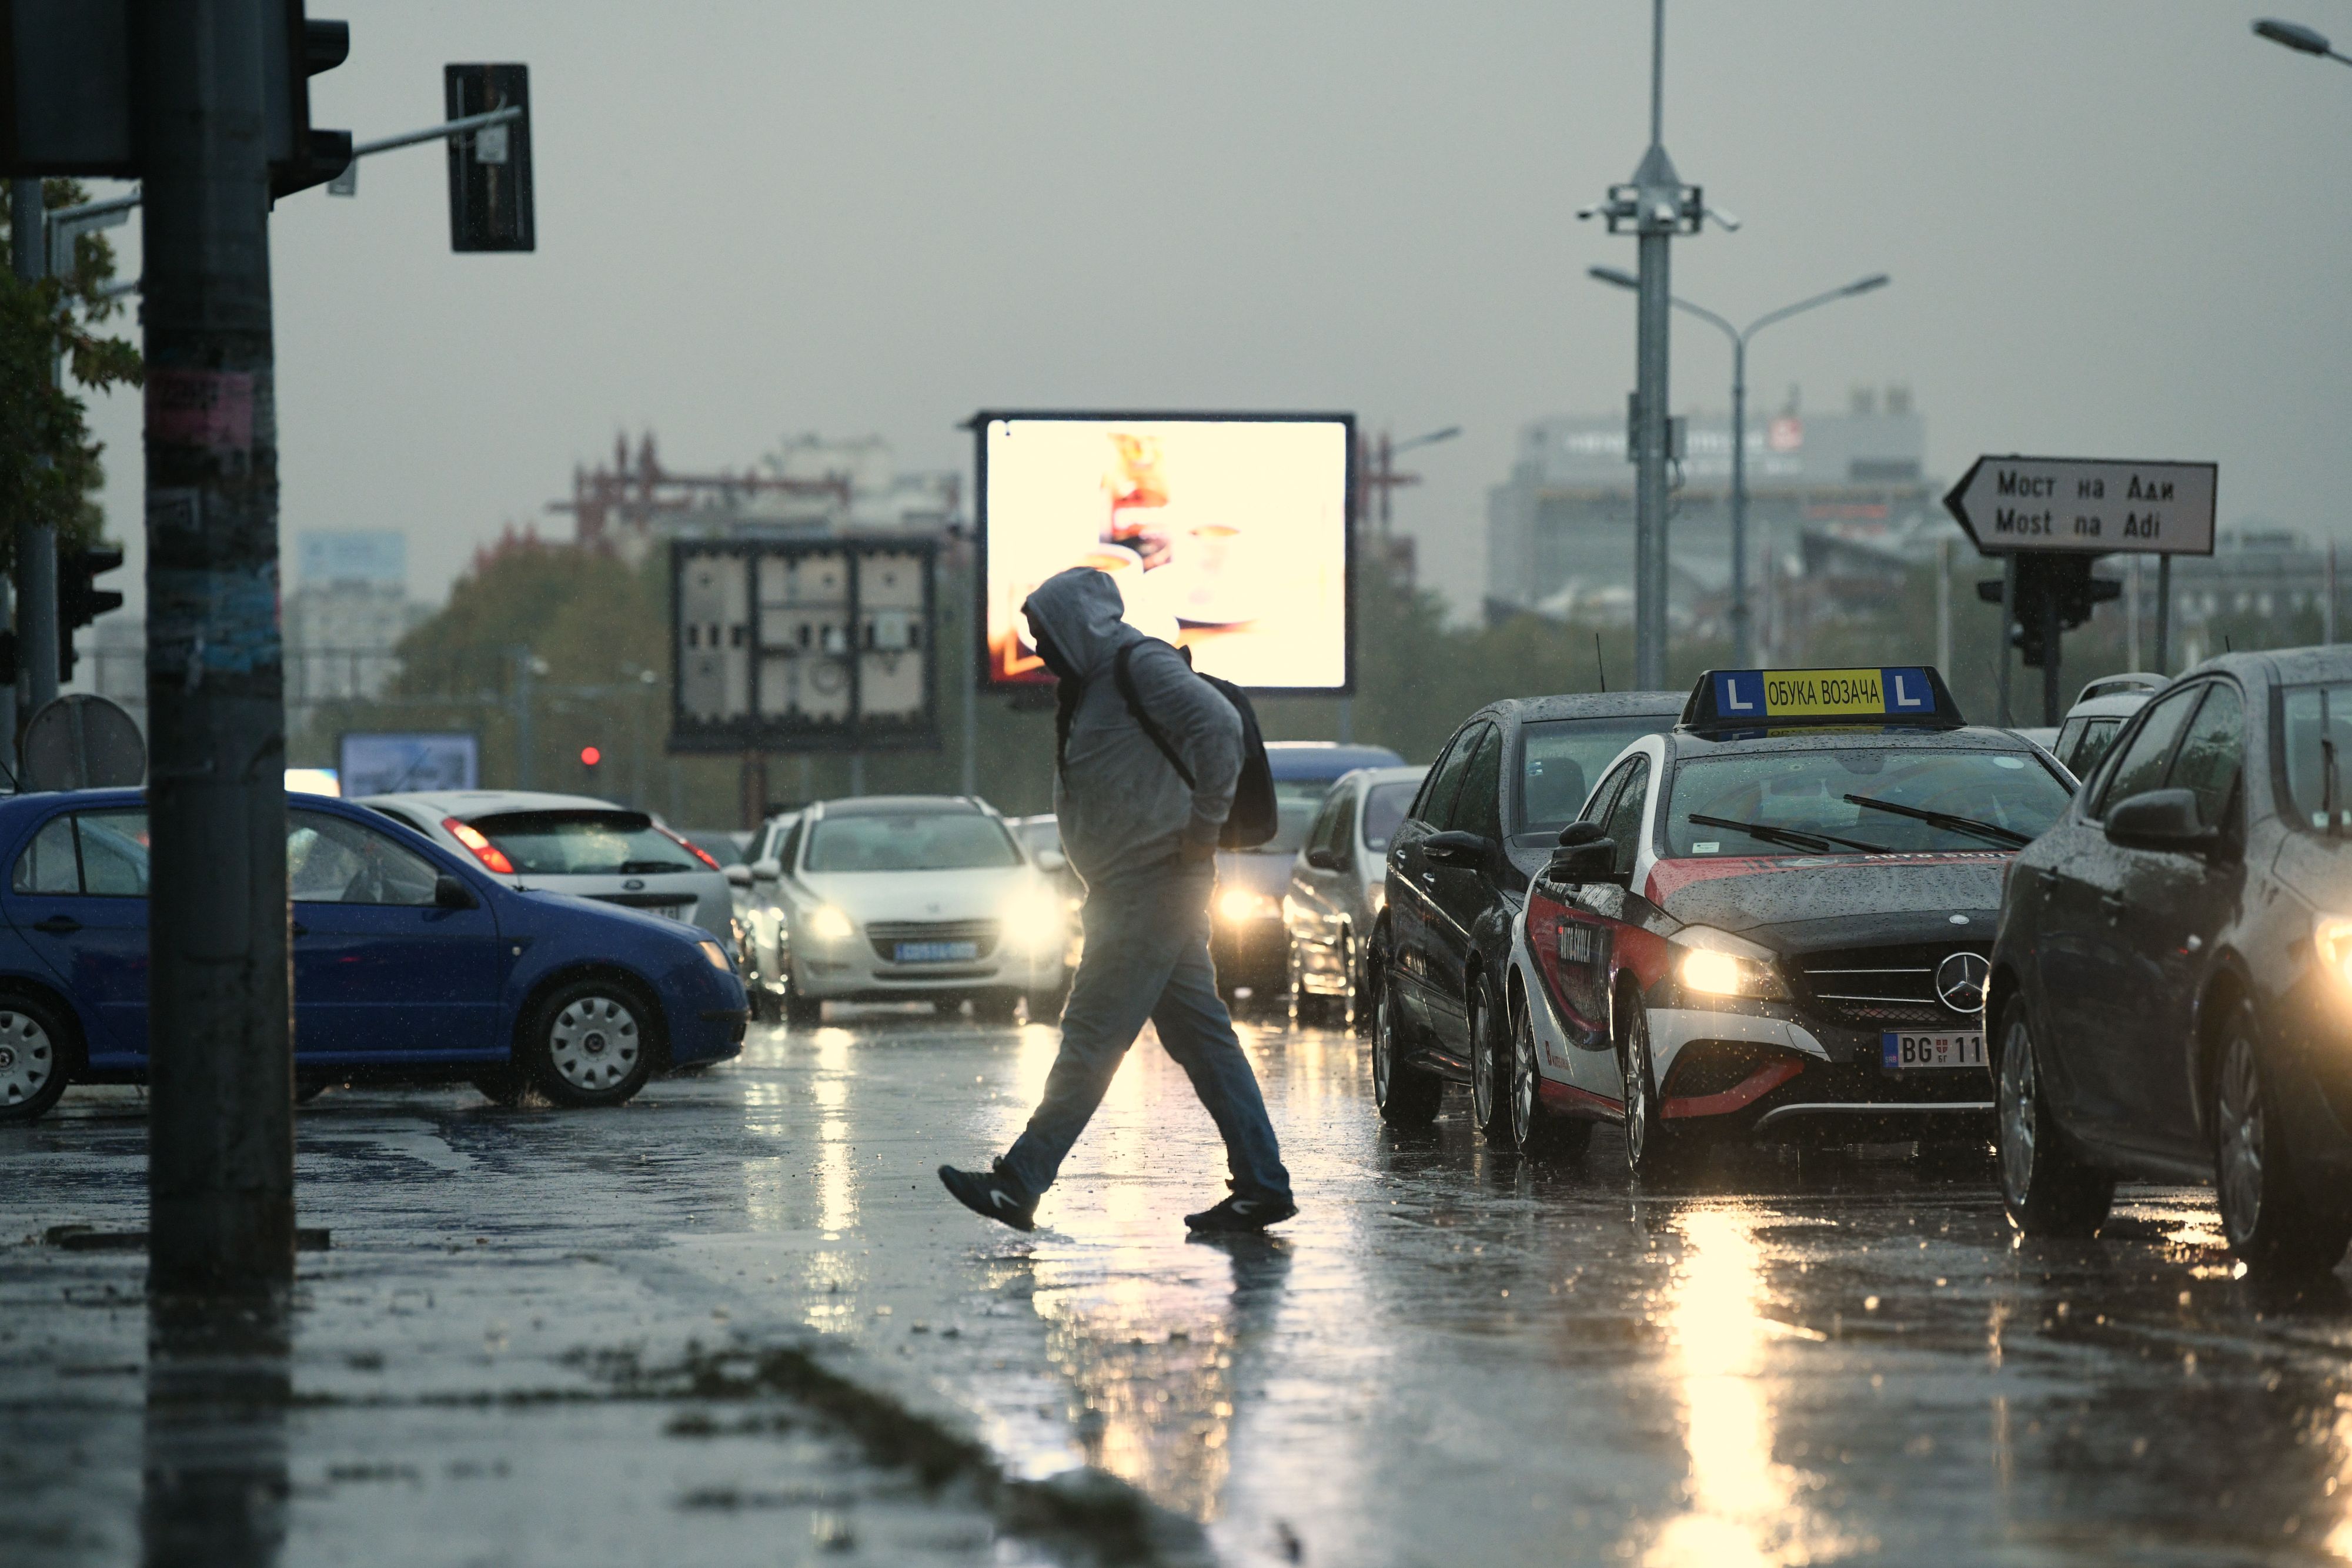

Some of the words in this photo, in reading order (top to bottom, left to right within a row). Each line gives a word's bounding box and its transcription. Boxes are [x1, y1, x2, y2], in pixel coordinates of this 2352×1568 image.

[1997, 469, 2057, 498] Мост
[2077, 478, 2106, 500] на
[2126, 473, 2174, 501] Ади
[1994, 507, 2052, 536] Most
[2073, 515, 2102, 538] na
[2123, 511, 2161, 539] Adi
[1728, 679, 1753, 709] L
[1769, 680, 1818, 706] ОБУКА
[1821, 679, 1880, 704] ВОЗАЧА
[1895, 676, 1921, 706] L
[1903, 1037, 1932, 1063] BG
